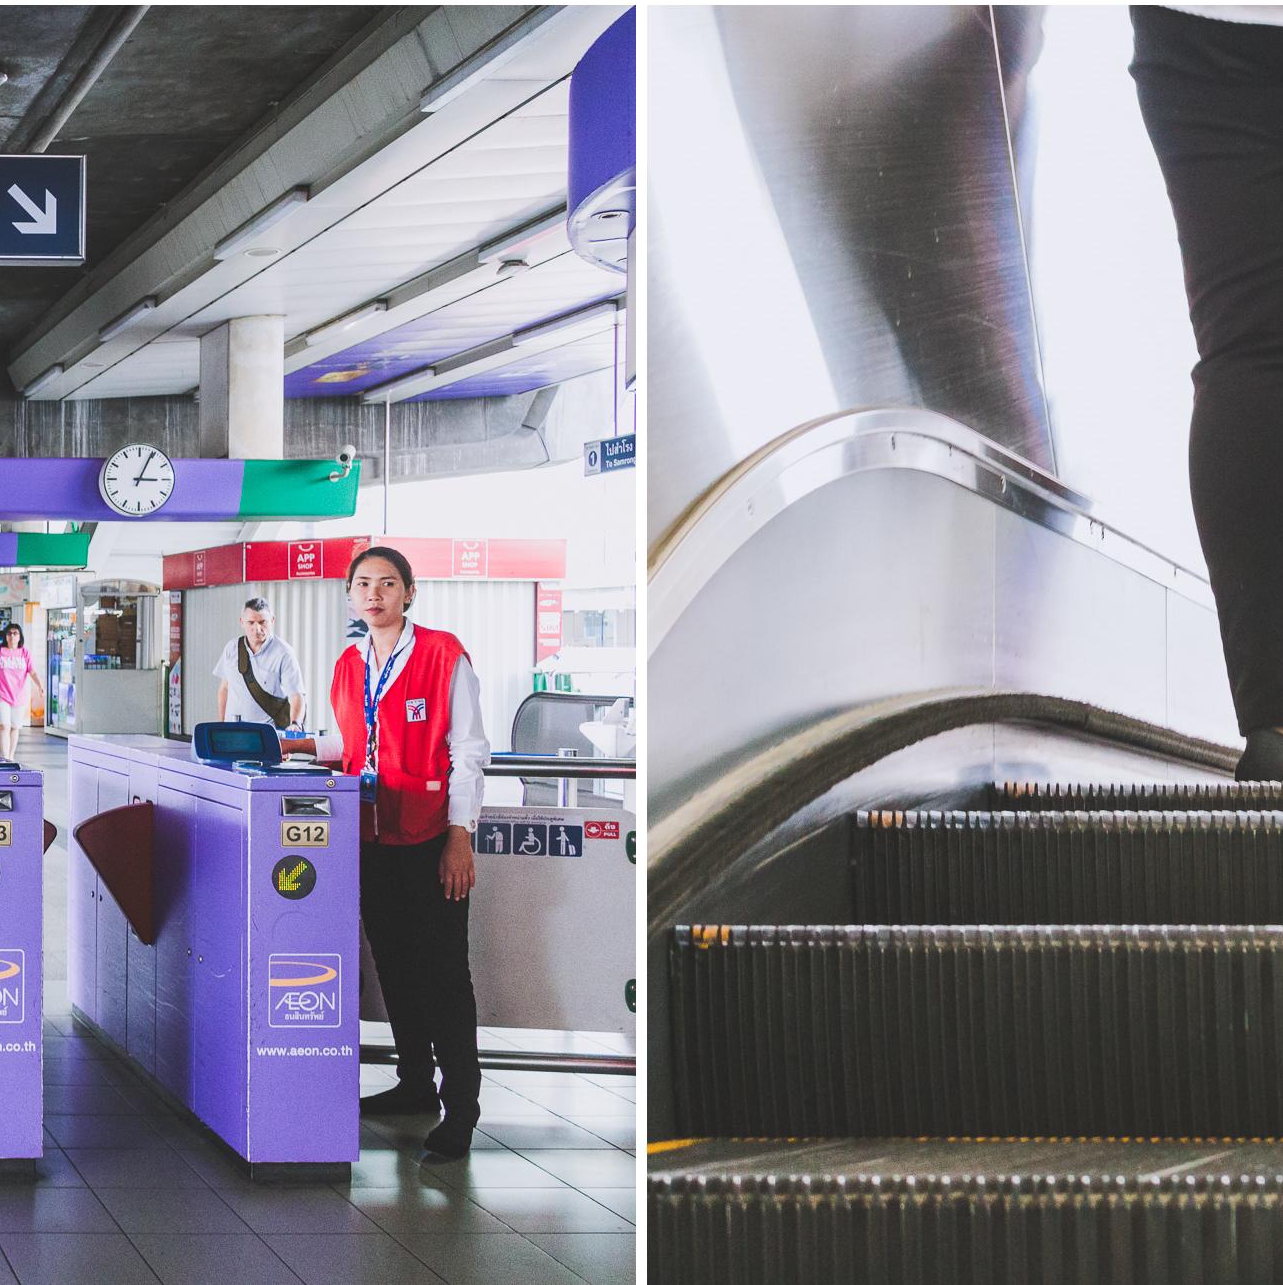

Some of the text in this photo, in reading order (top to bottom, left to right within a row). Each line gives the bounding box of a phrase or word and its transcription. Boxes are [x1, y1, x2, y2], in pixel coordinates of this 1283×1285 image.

[605, 438, 633, 456] ไปสำโรง
[605, 460, 613, 468] To
[297, 553, 316, 563] APP
[286, 825, 325, 842] G12
[256, 1045, 353, 1057] www.aeon.co.th
